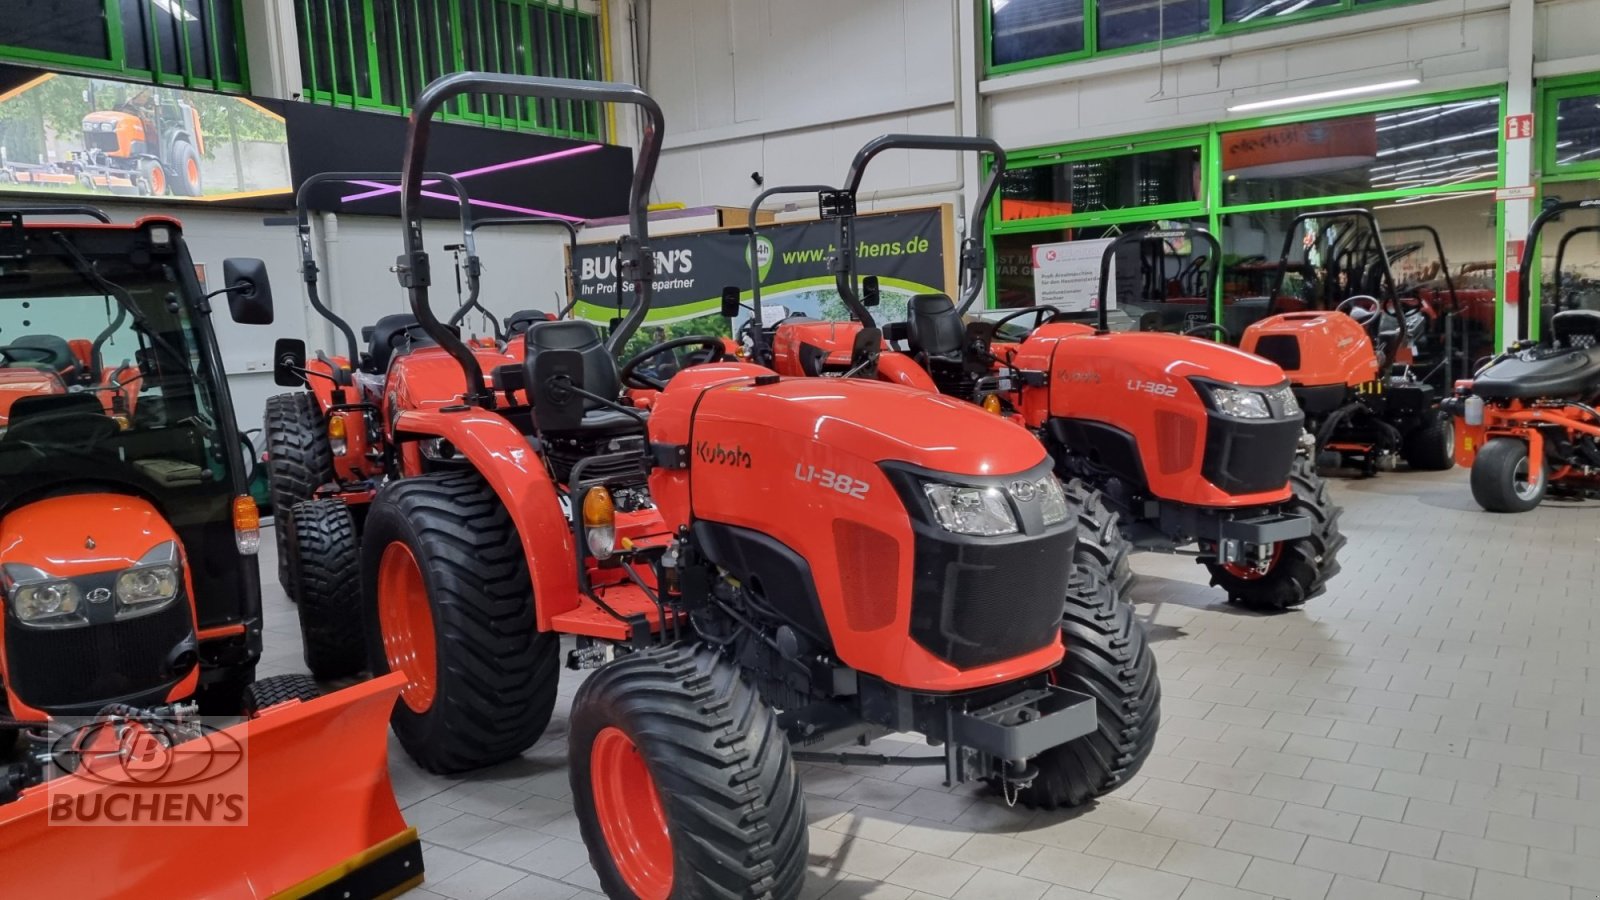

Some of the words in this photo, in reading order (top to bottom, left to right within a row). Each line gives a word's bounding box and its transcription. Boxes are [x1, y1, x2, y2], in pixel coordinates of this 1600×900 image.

[782, 236, 929, 265] www.hens.de
[580, 249, 693, 281] BUCN'S
[581, 284, 594, 296] Ihr
[596, 282, 618, 295] Prof
[622, 279, 694, 292] Seepartner
[1127, 380, 1178, 398] L1-382
[696, 441, 752, 469] Kubota
[795, 463, 870, 500] L1-382
